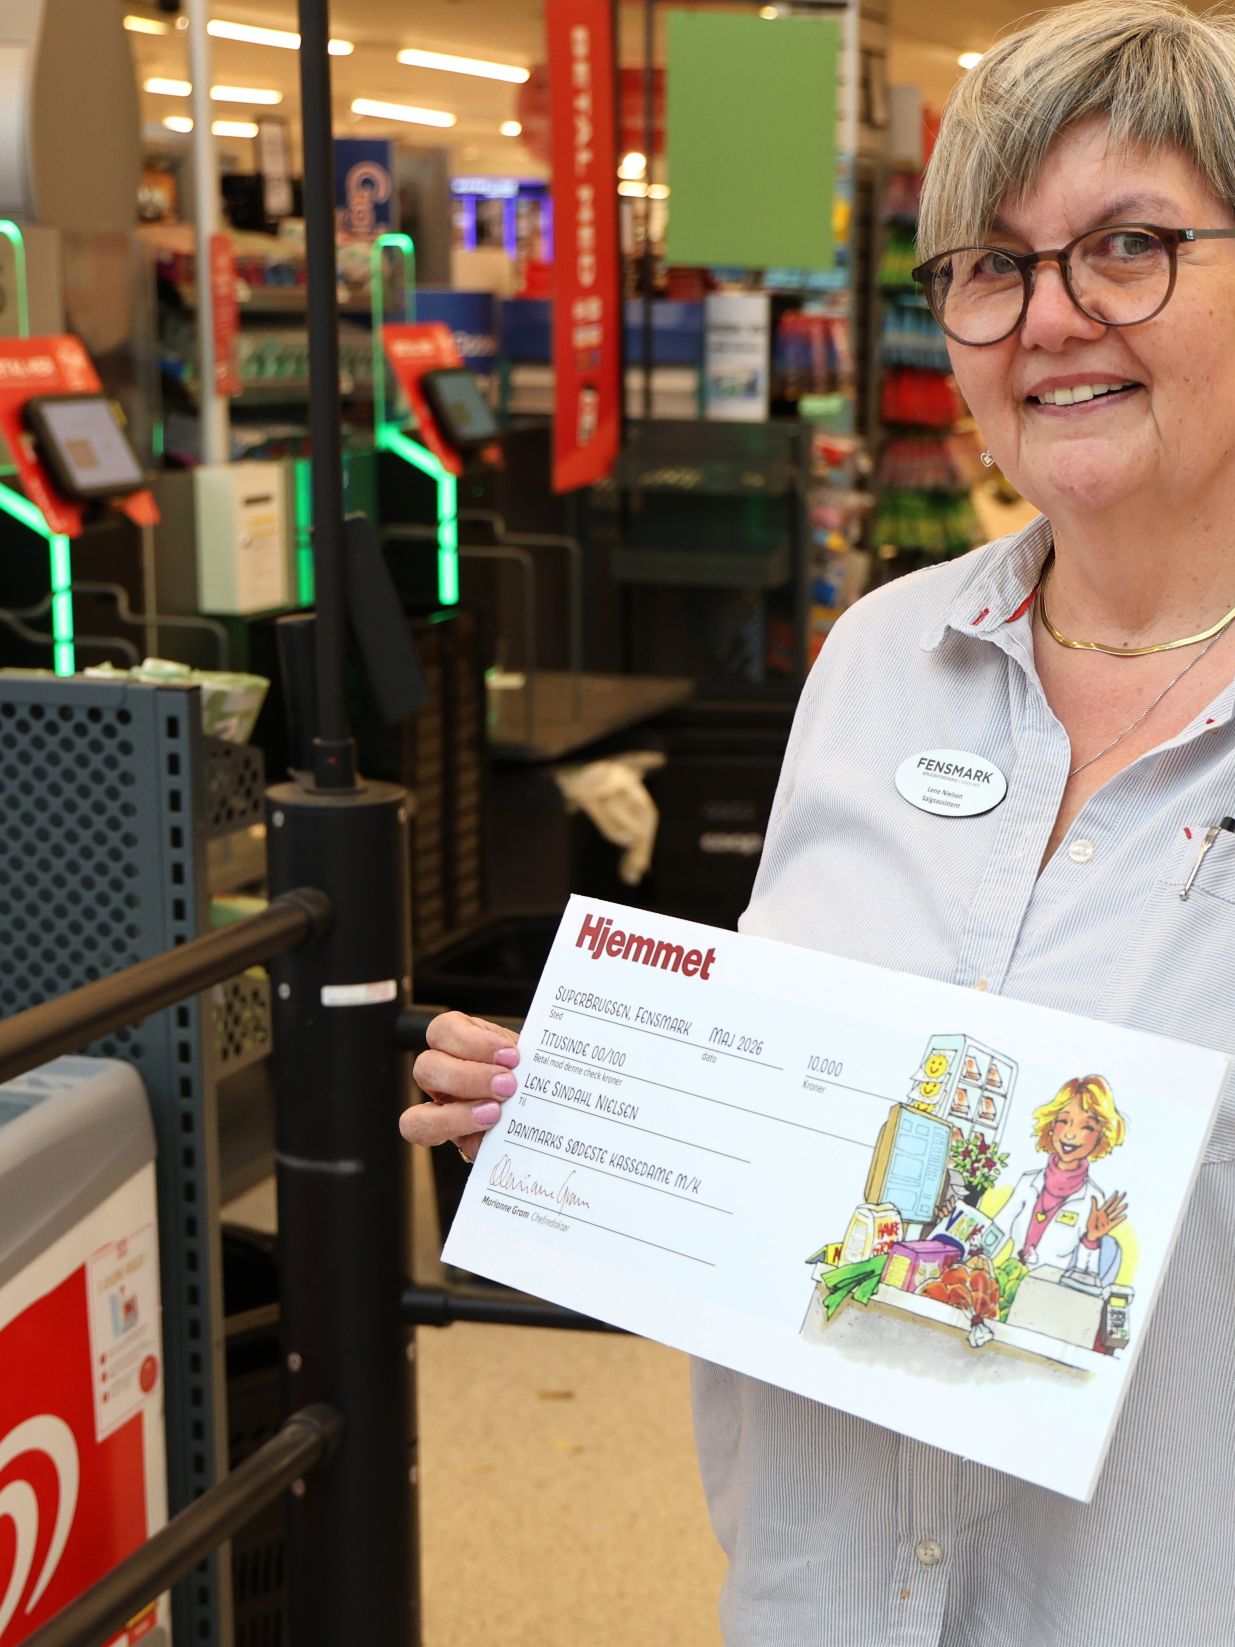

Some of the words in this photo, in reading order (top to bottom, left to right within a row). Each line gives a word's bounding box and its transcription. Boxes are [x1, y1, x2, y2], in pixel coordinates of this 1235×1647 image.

[917, 757, 994, 784] FENSMARK
[921, 795, 960, 808] Salgsassistent
[927, 787, 940, 795] Lene
[941, 790, 963, 799] Nielsen
[576, 913, 715, 980] Hjemmet
[549, 1009, 563, 1021] Sted
[591, 1045, 626, 1067] 00/100
[701, 1051, 717, 1064] dato
[736, 1035, 764, 1056] 2026
[806, 1055, 843, 1077] 10.000
[533, 1053, 549, 1065] Betal
[550, 1059, 563, 1069] mod
[564, 1063, 583, 1075] denne
[583, 1068, 601, 1080] check
[602, 1074, 622, 1087] kroner
[802, 1080, 826, 1094] Kroner
[518, 1096, 527, 1107] Til
[481, 1195, 511, 1213] Marianne
[511, 1205, 529, 1219] Gram
